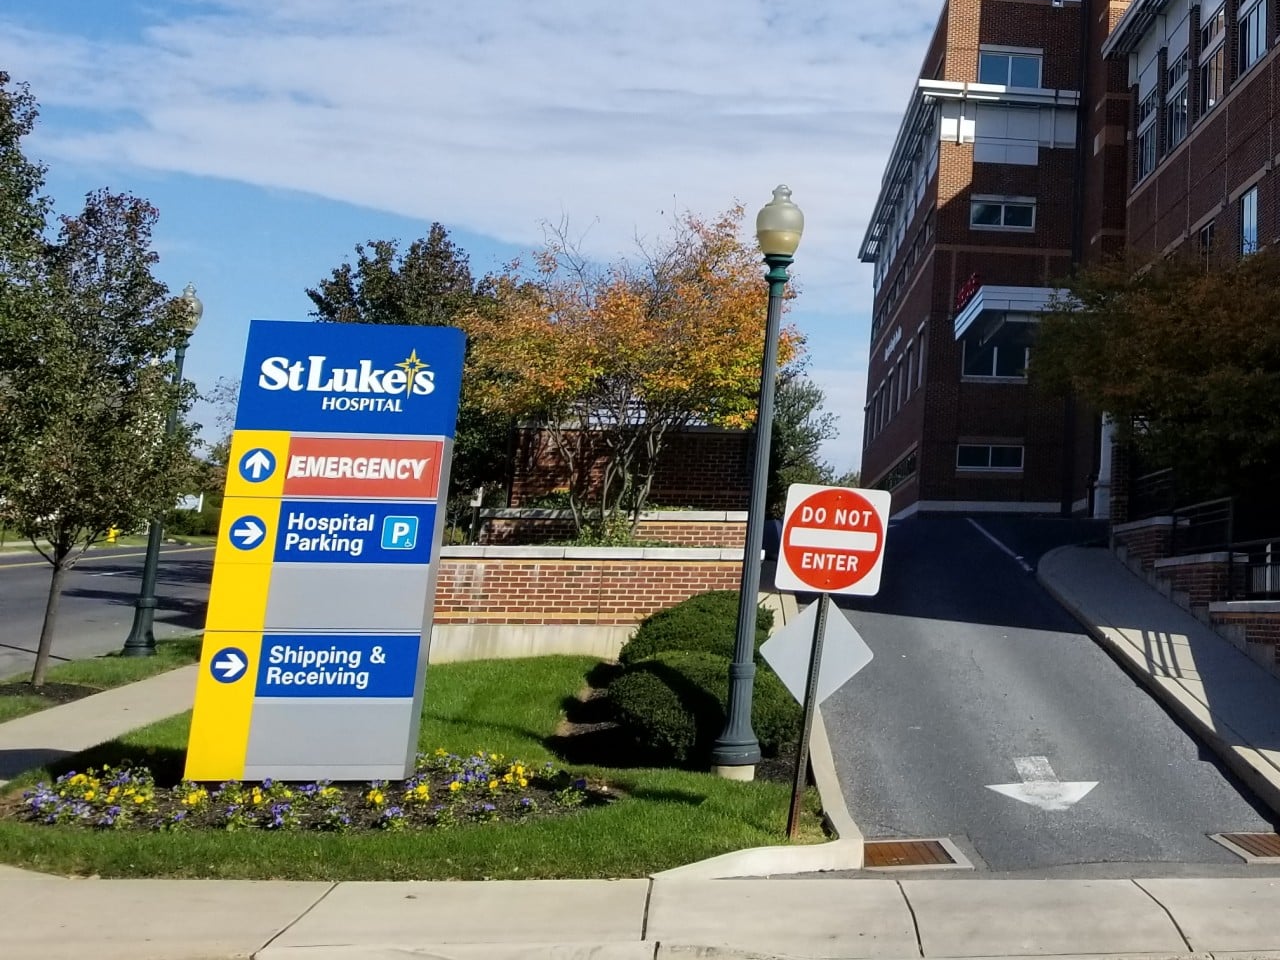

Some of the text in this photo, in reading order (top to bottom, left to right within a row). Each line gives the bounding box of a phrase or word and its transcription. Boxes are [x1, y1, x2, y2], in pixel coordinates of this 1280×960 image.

[321, 396, 403, 412] HOSPITAL
[286, 454, 431, 480] EMERGENCY
[801, 506, 872, 527] DO NOT
[287, 512, 410, 544] Hospital P
[284, 534, 363, 556] Parking
[801, 552, 859, 572] ENTER
[268, 645, 386, 668] Shipping &
[266, 666, 369, 690] Receiving
